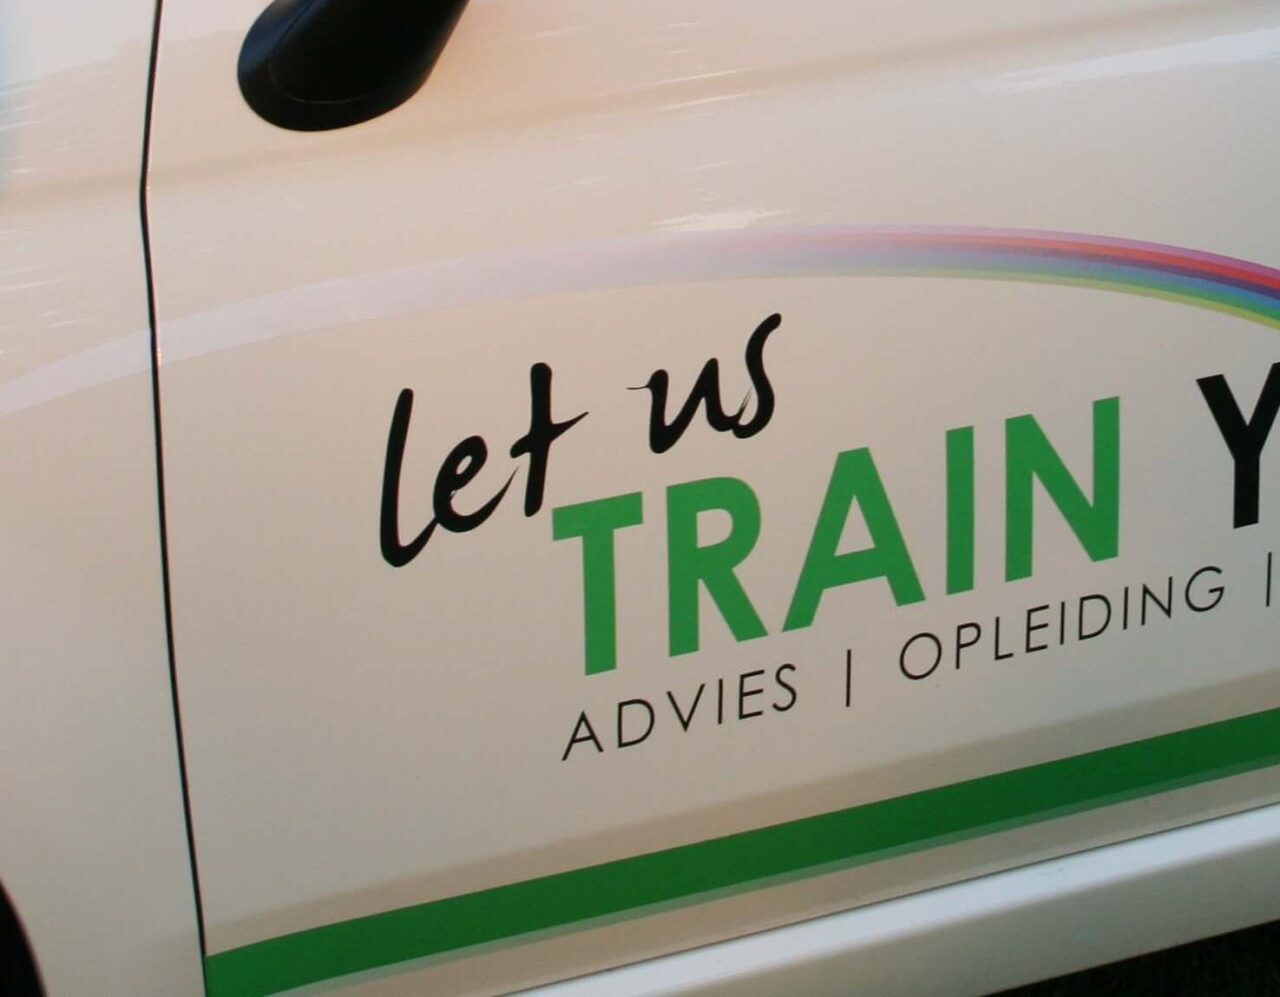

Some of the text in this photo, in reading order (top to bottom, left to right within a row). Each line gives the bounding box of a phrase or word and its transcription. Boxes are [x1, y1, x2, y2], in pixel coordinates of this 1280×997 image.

[379, 313, 782, 568] let us
[552, 395, 1120, 676] TRAIN
[562, 664, 798, 762] ADVIES
[899, 566, 1226, 681] OPLEIDING
